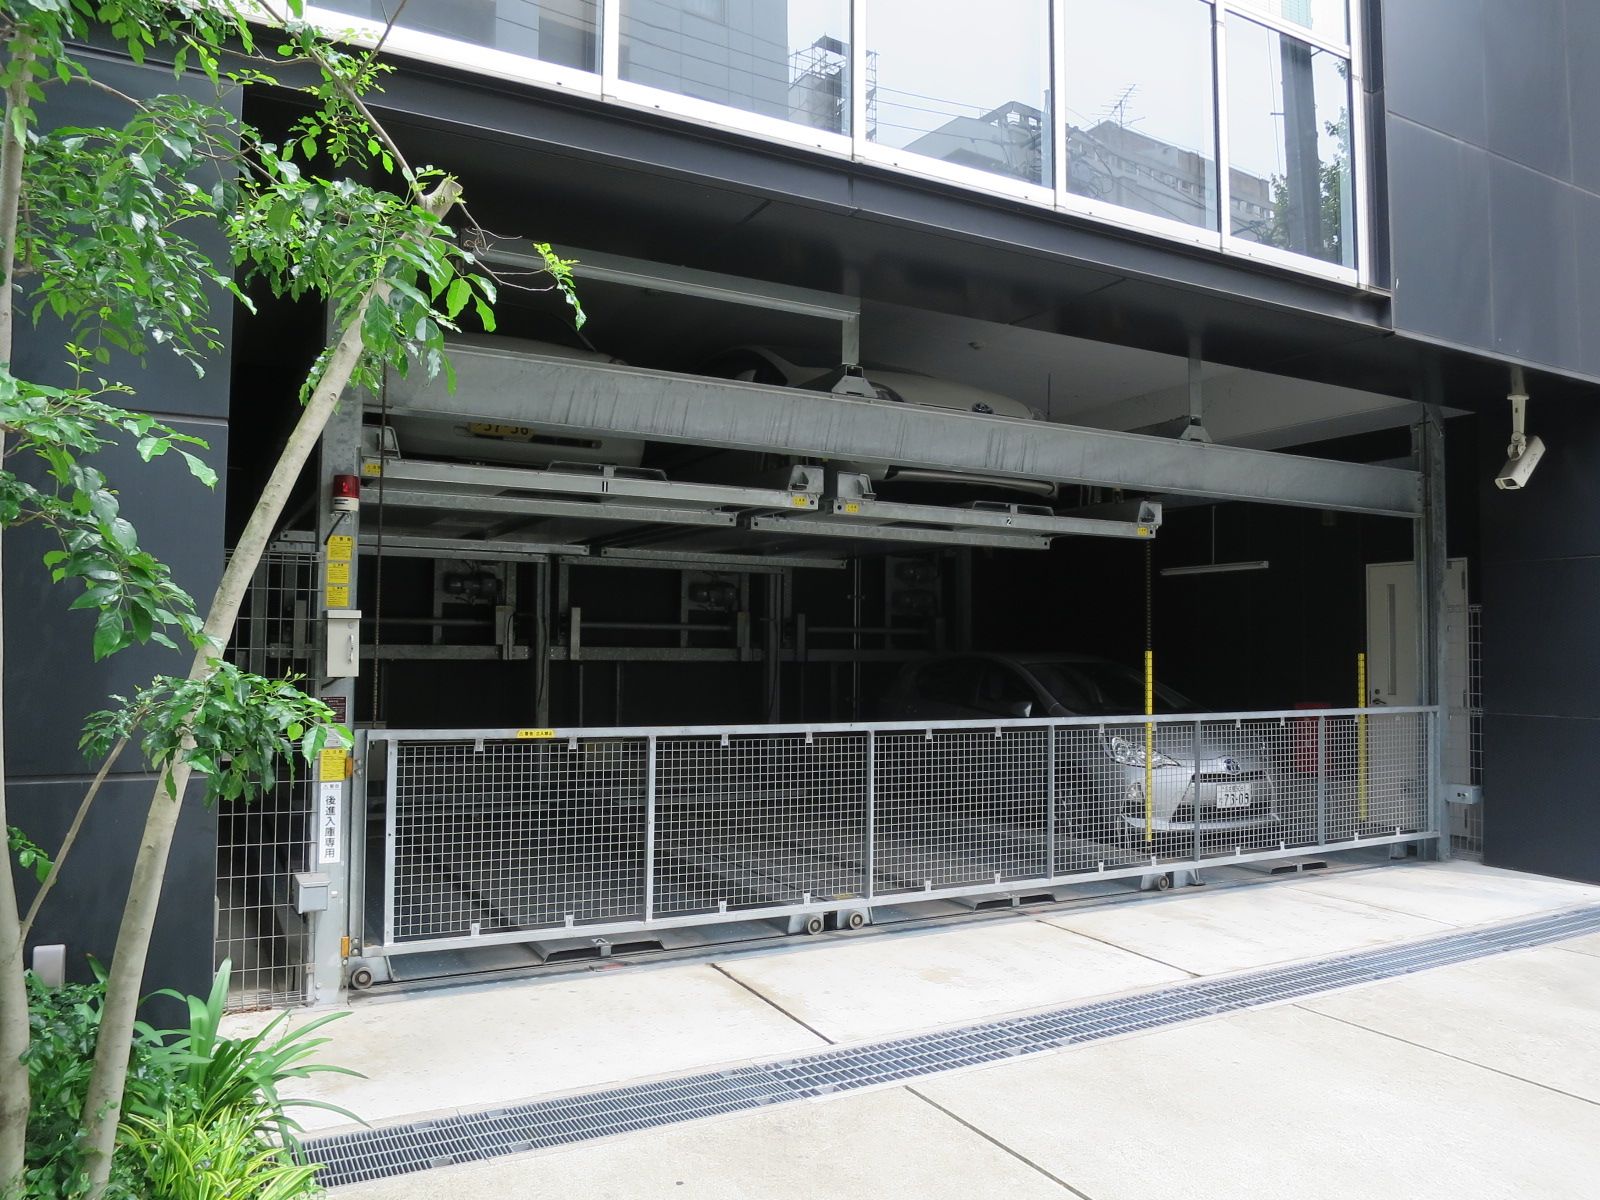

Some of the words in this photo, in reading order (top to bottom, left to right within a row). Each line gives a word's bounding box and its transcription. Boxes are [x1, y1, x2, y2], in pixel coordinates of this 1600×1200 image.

[325, 795, 336, 859] 後進入庫専用
